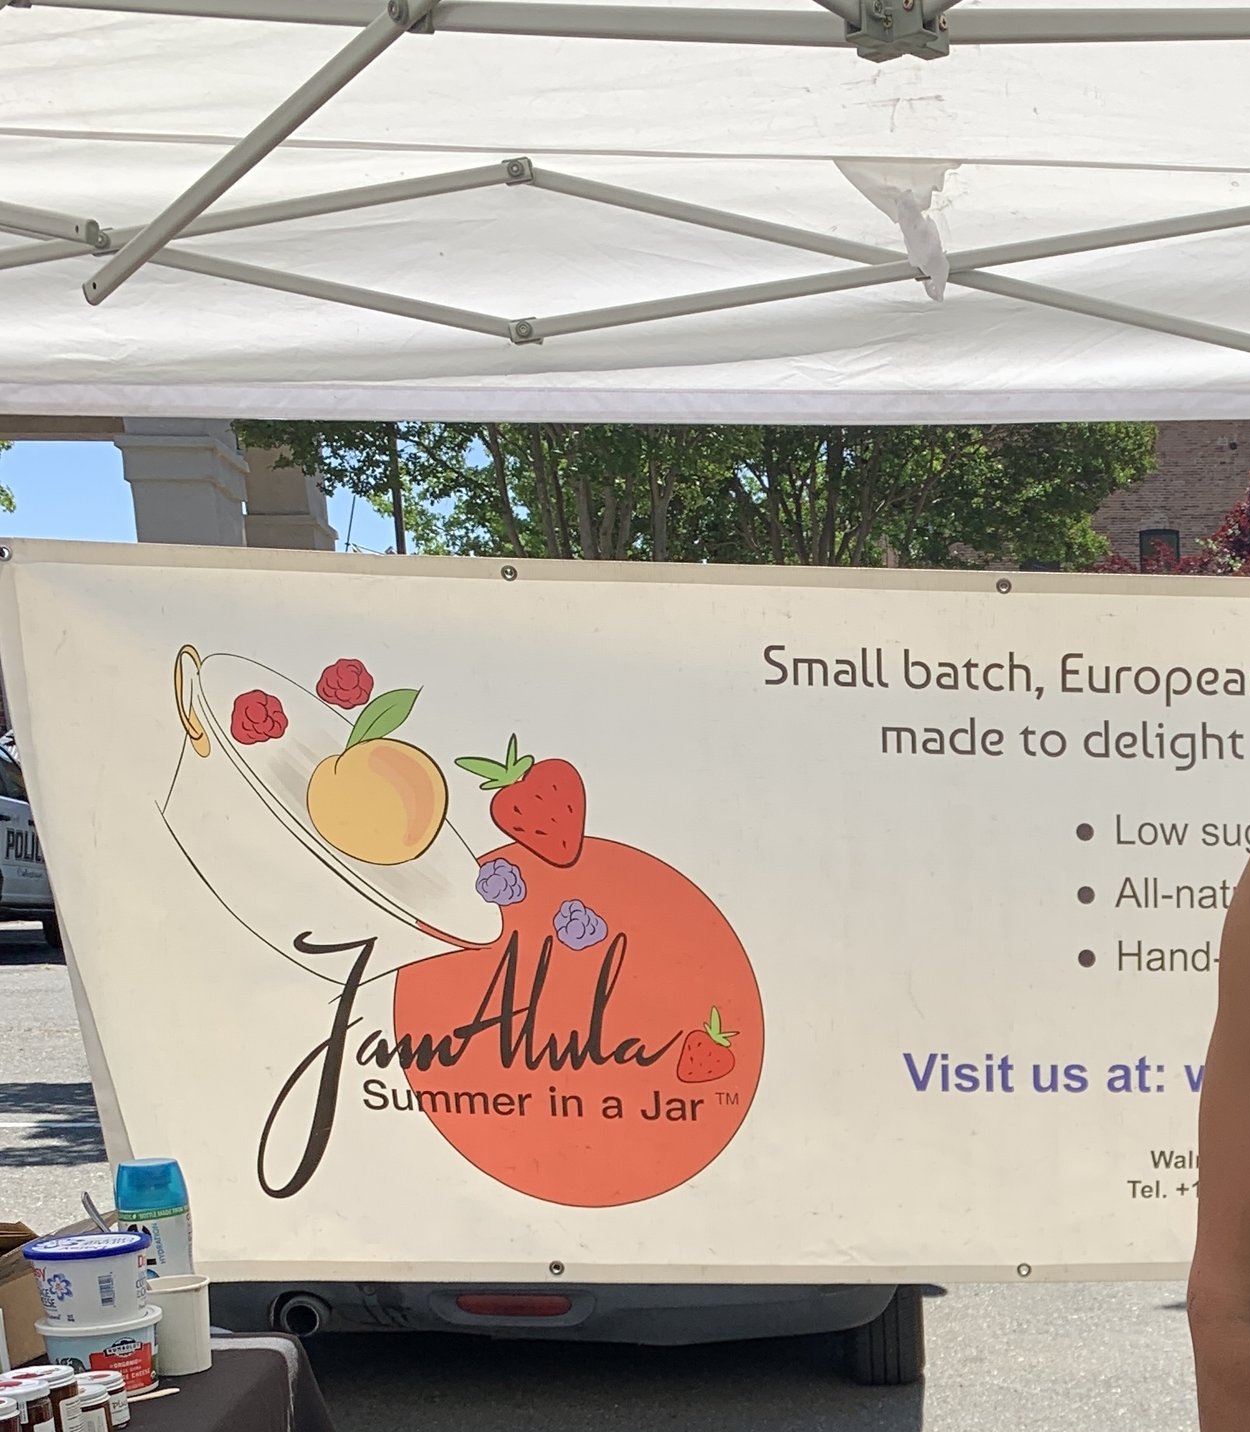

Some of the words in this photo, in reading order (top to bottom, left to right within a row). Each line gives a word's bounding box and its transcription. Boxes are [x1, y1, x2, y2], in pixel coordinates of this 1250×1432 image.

[763, 646, 889, 688] Small
[903, 650, 1045, 700] batch,
[881, 718, 1004, 757] made
[1019, 722, 1067, 758] to
[1084, 720, 1244, 770] delight
[1116, 814, 1189, 845] Low
[1115, 877, 1237, 909] All-nat
[1118, 940, 1220, 971] Hand-
[257, 930, 683, 1199] JamAlula
[903, 1052, 1014, 1093] Visit
[1031, 1062, 1089, 1093] us
[1106, 1056, 1165, 1093] at:
[363, 1079, 532, 1117] Summer
[549, 1086, 583, 1119] in
[603, 1096, 624, 1120] a
[641, 1090, 705, 1122] Jar
[1151, 1150, 1199, 1169] Wal
[1127, 1180, 1167, 1199] Tel.
